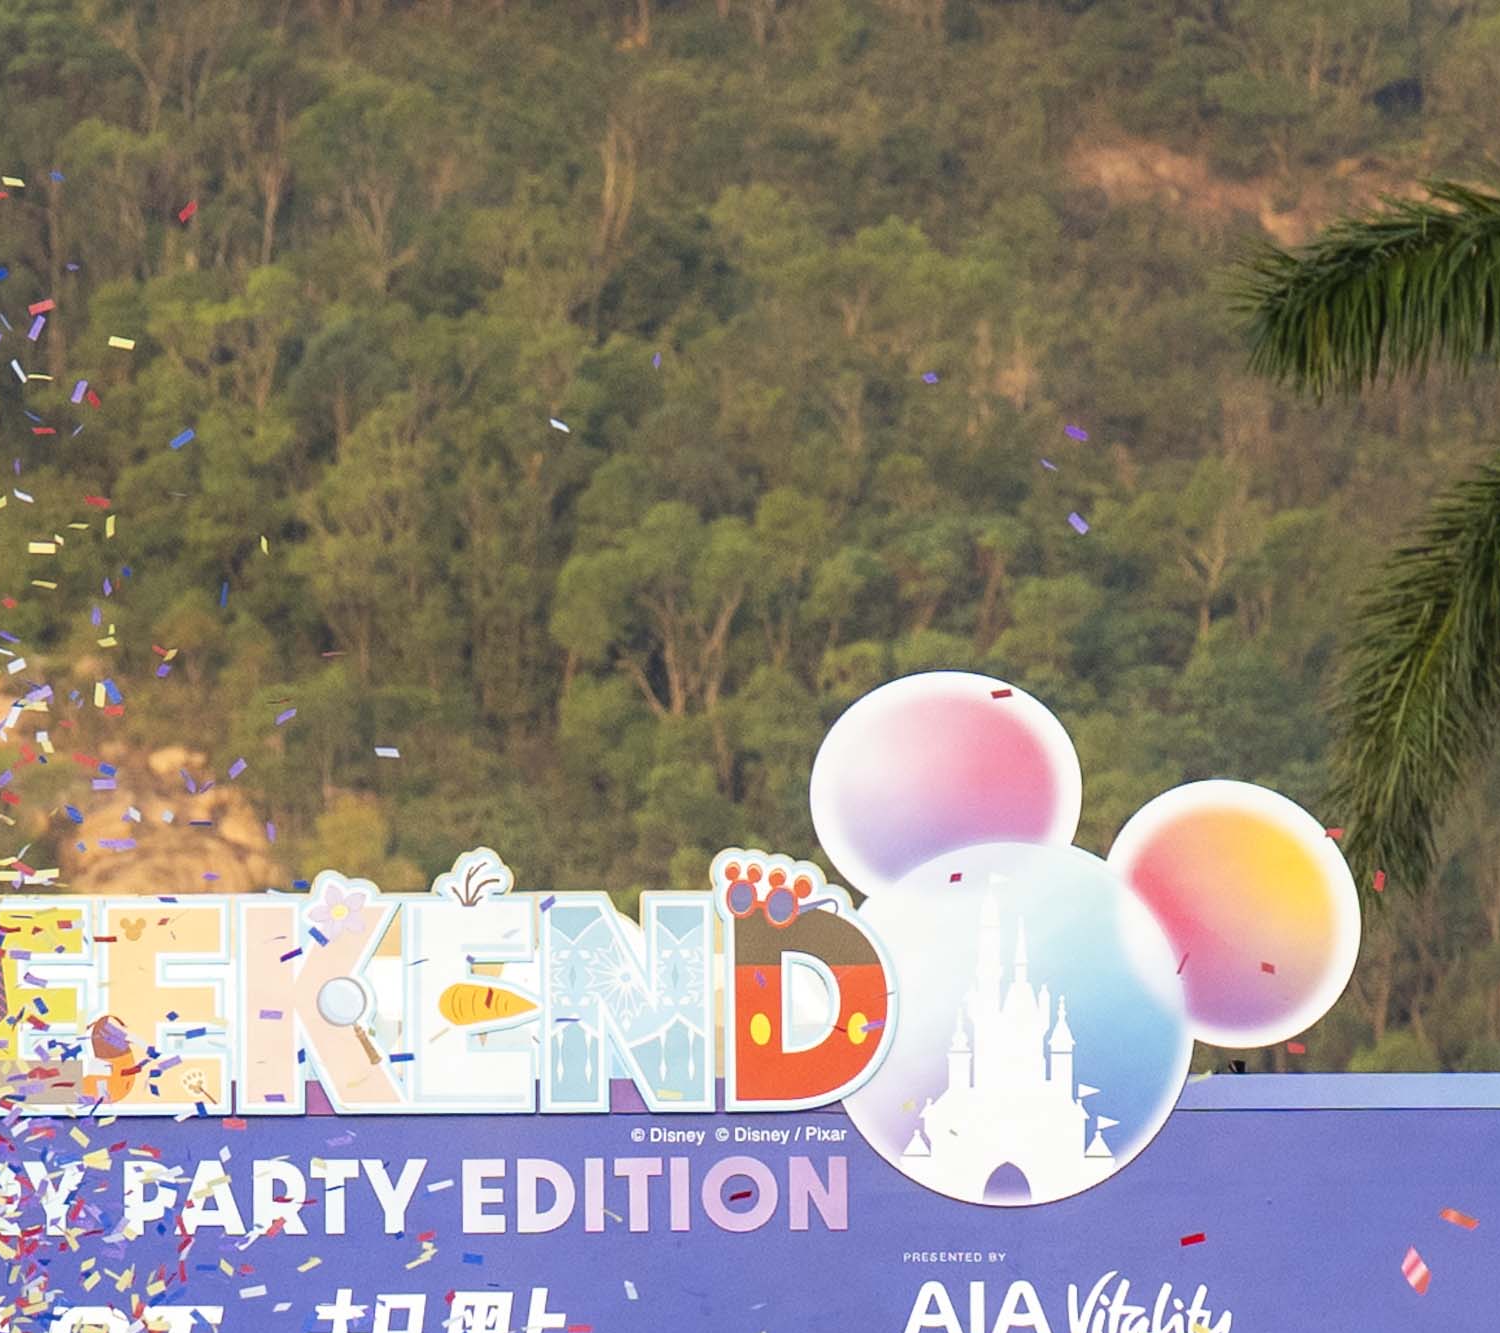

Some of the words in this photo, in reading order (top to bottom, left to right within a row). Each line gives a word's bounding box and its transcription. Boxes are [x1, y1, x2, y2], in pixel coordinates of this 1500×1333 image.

[649, 1126, 704, 1147] Disney
[734, 1126, 789, 1147] Disney
[805, 1126, 847, 1143] Pixar
[123, 1158, 428, 1237] PARTY
[462, 1155, 849, 1233] EDITION
[903, 1251, 983, 1263] PRESENTED
[988, 1251, 1007, 1263] BY
